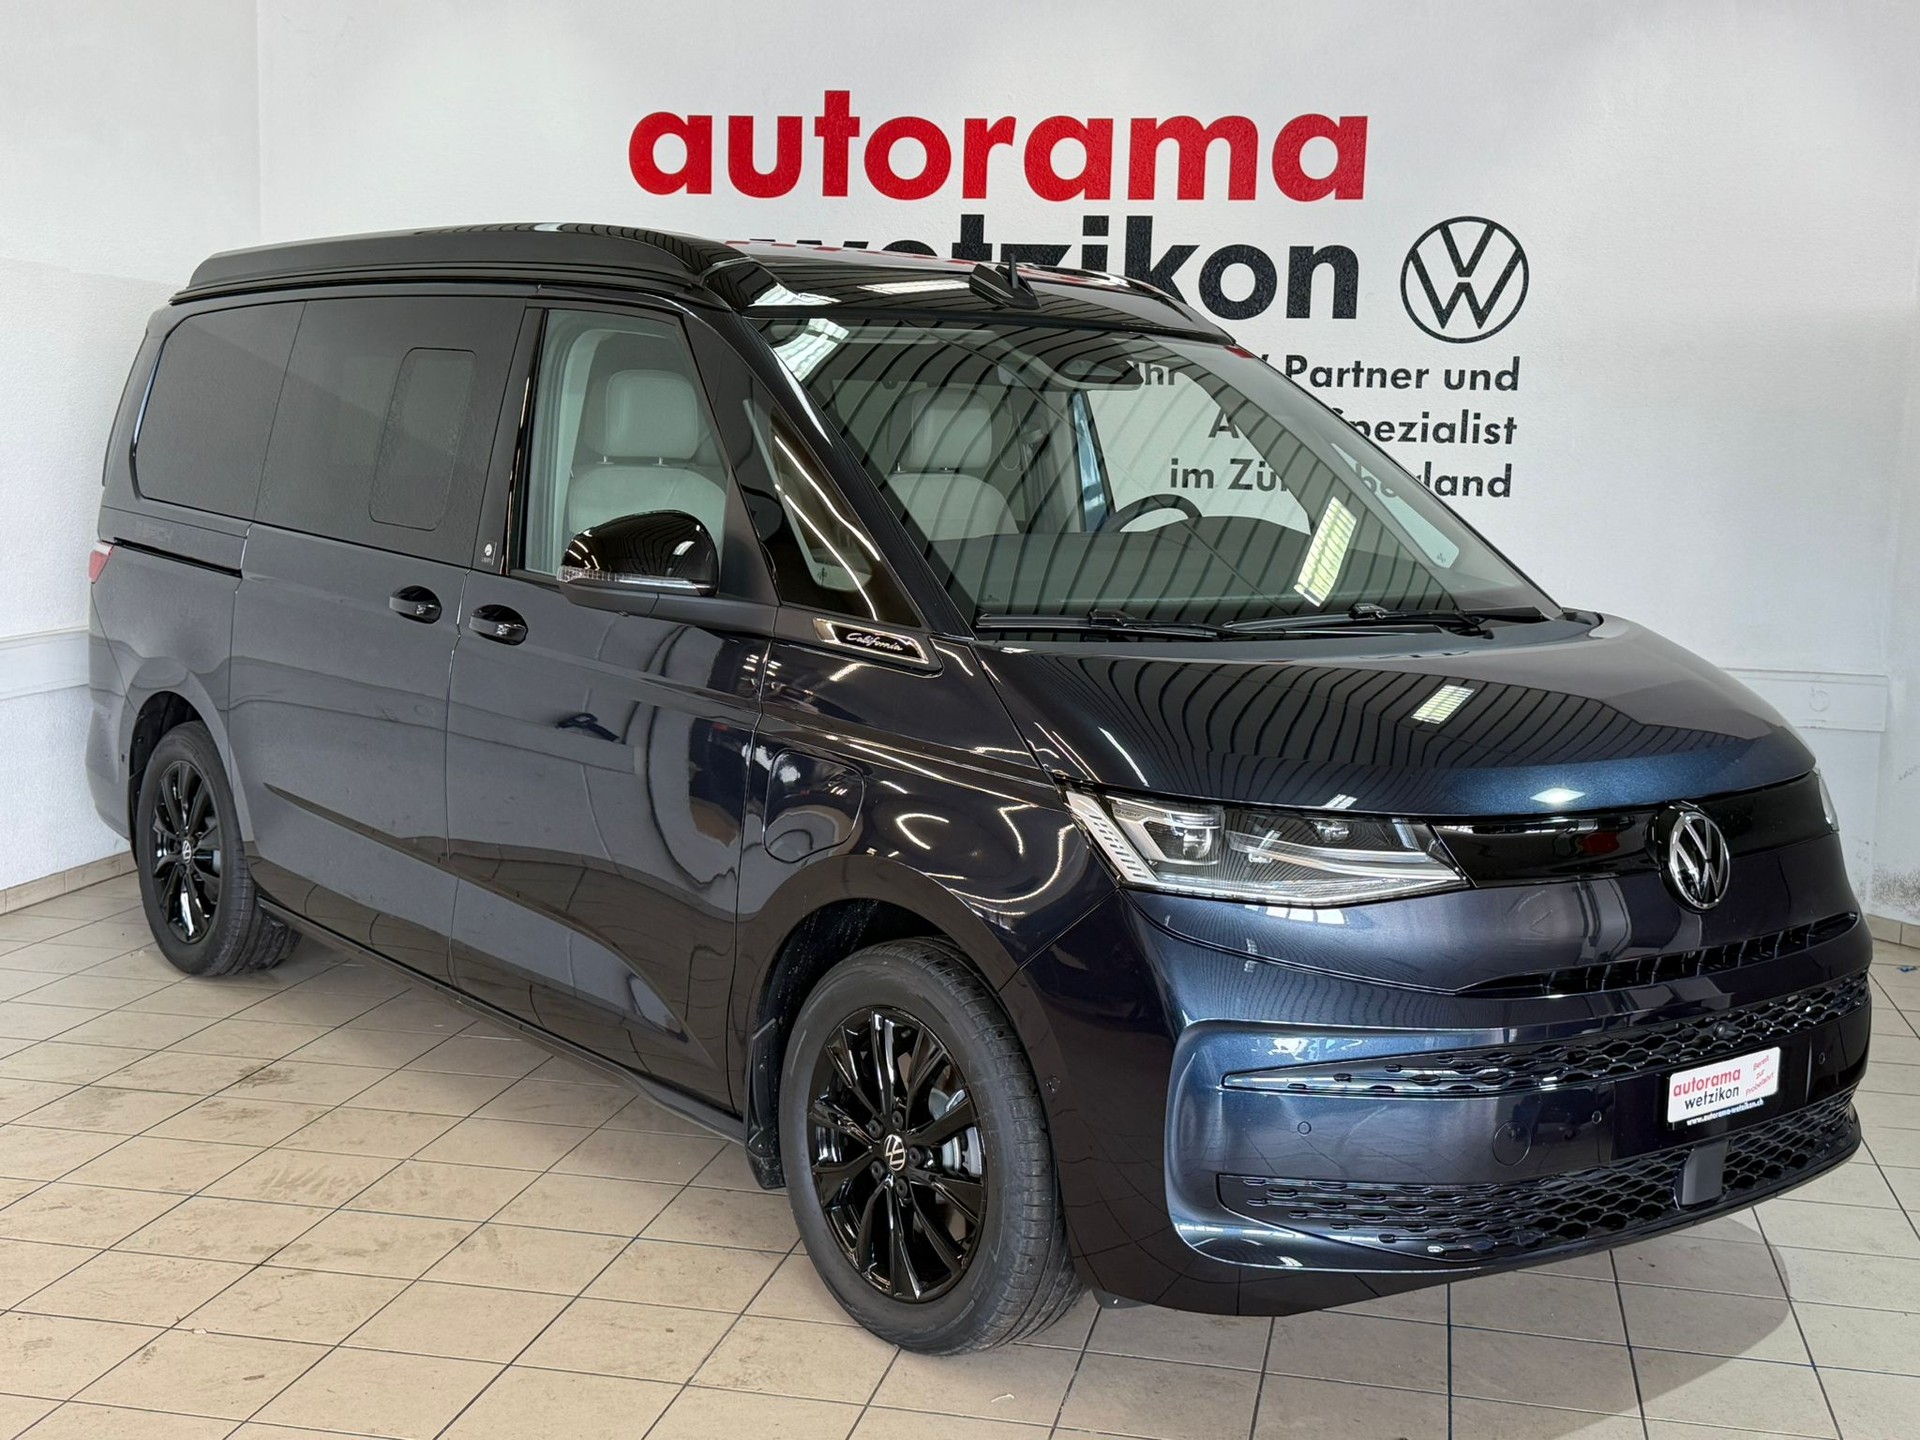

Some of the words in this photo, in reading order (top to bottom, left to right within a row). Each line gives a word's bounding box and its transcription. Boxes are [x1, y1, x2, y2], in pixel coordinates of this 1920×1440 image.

[628, 90, 1369, 202] autorama
[1285, 354, 1430, 390] Partner
[1444, 356, 1520, 392] und
[1170, 458, 1215, 489] im
[846, 632, 903, 651] California
[1673, 1068, 1741, 1098] autorama
[1684, 1085, 1740, 1111] wetzikon
